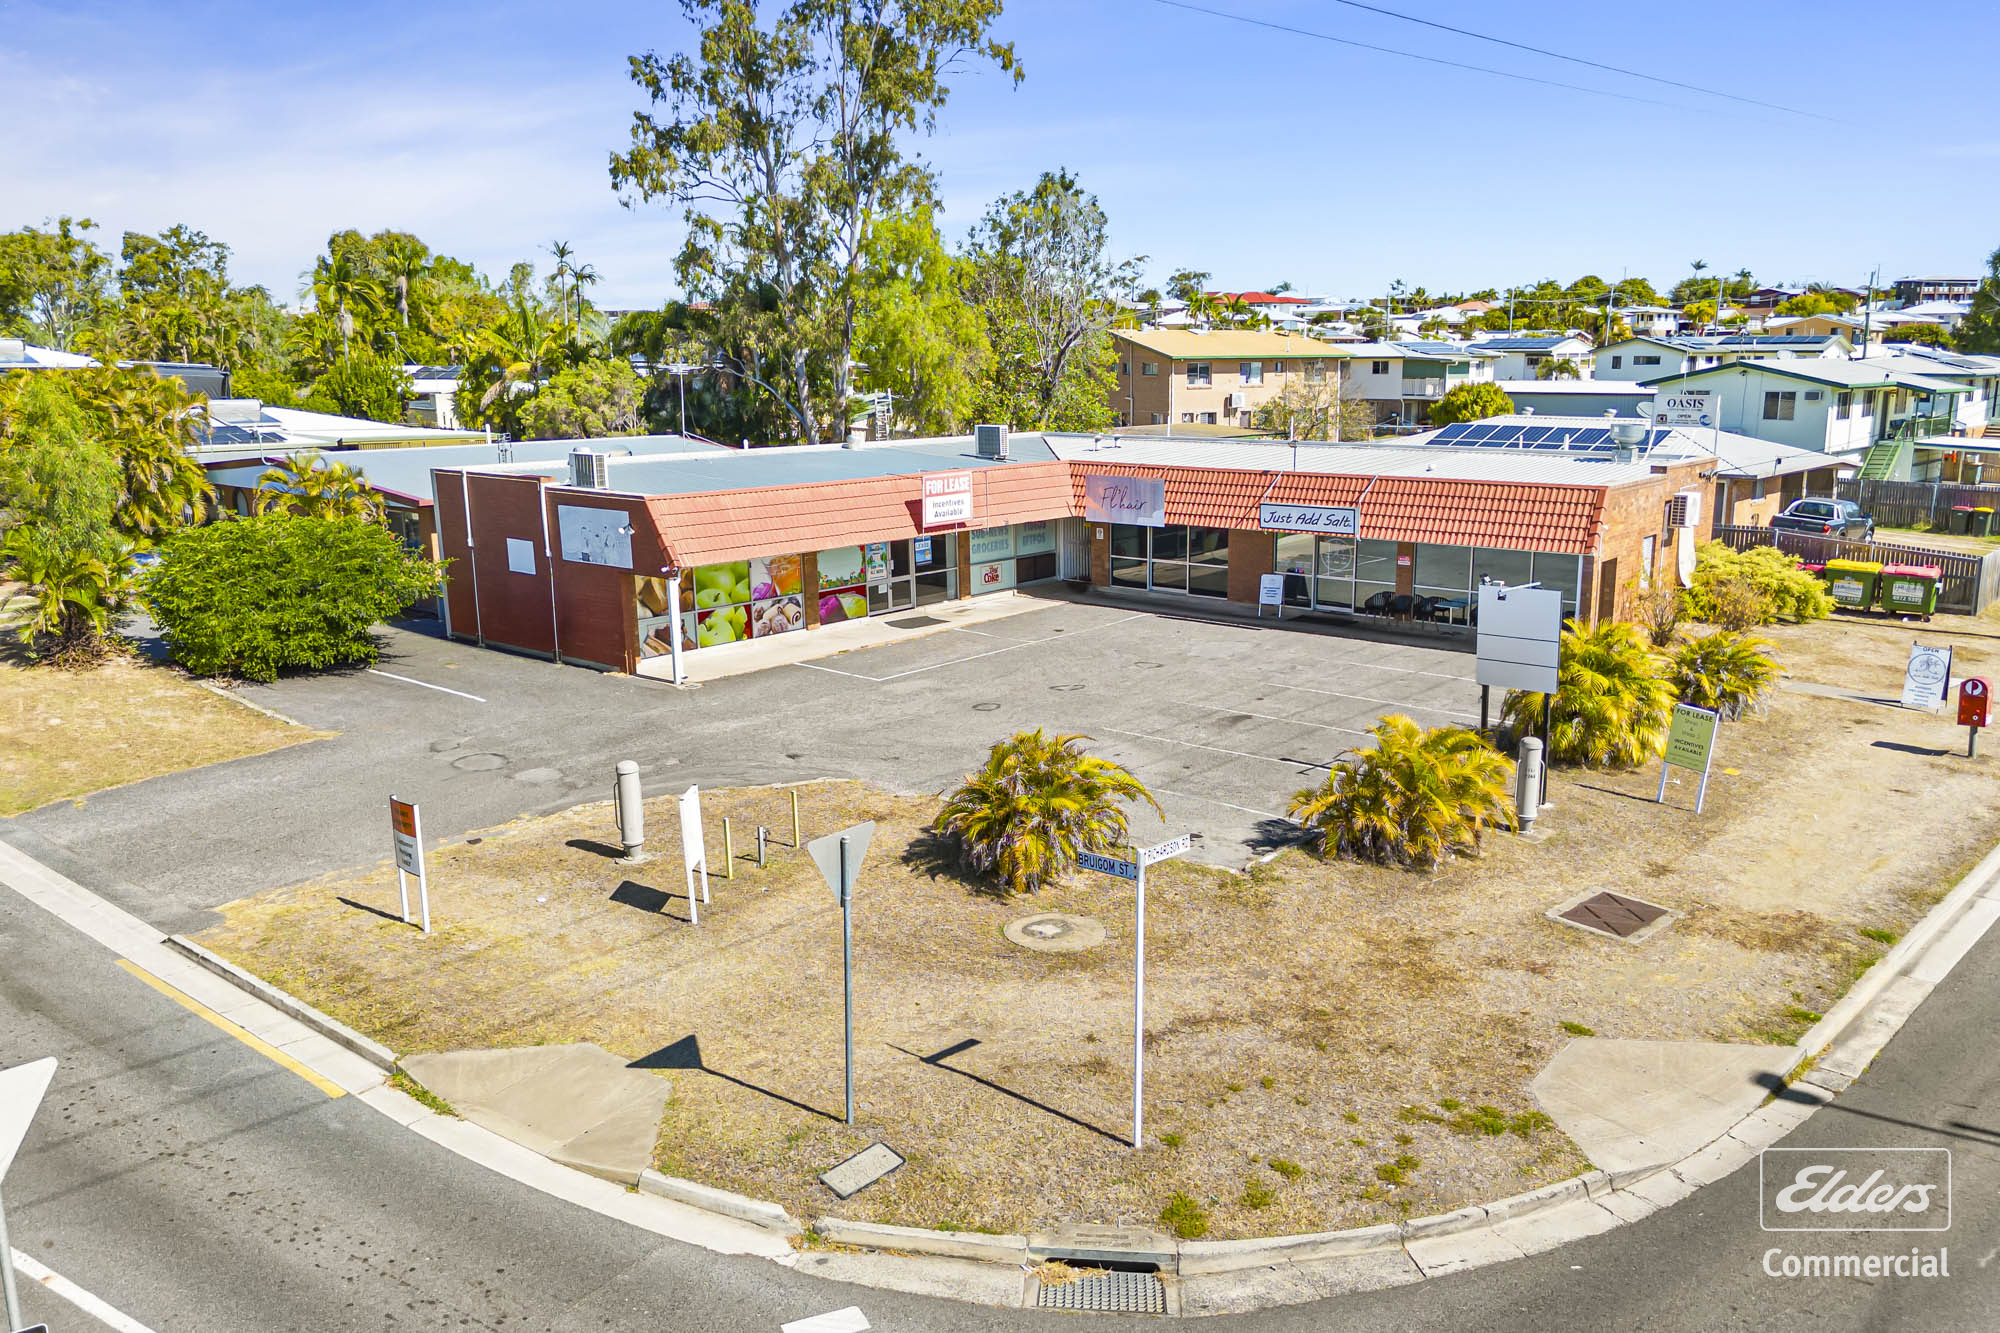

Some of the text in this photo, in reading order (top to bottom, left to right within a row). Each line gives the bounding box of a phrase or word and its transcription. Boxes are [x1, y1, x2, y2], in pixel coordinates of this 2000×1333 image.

[1667, 398, 1704, 408] OASIS
[925, 476, 970, 496] FOR LEASE
[932, 499, 964, 509] Incentives
[934, 509, 962, 518] Available
[1263, 511, 1292, 524] Just
[1295, 512, 1322, 526] Add
[971, 539, 1009, 554] GROCERIES
[1676, 708, 1713, 723] FOR LEASE
[1673, 738, 1704, 750] INCENTIVES
[1674, 745, 1703, 756] AVAILABLE
[1078, 853, 1116, 873] BRUIGOM
